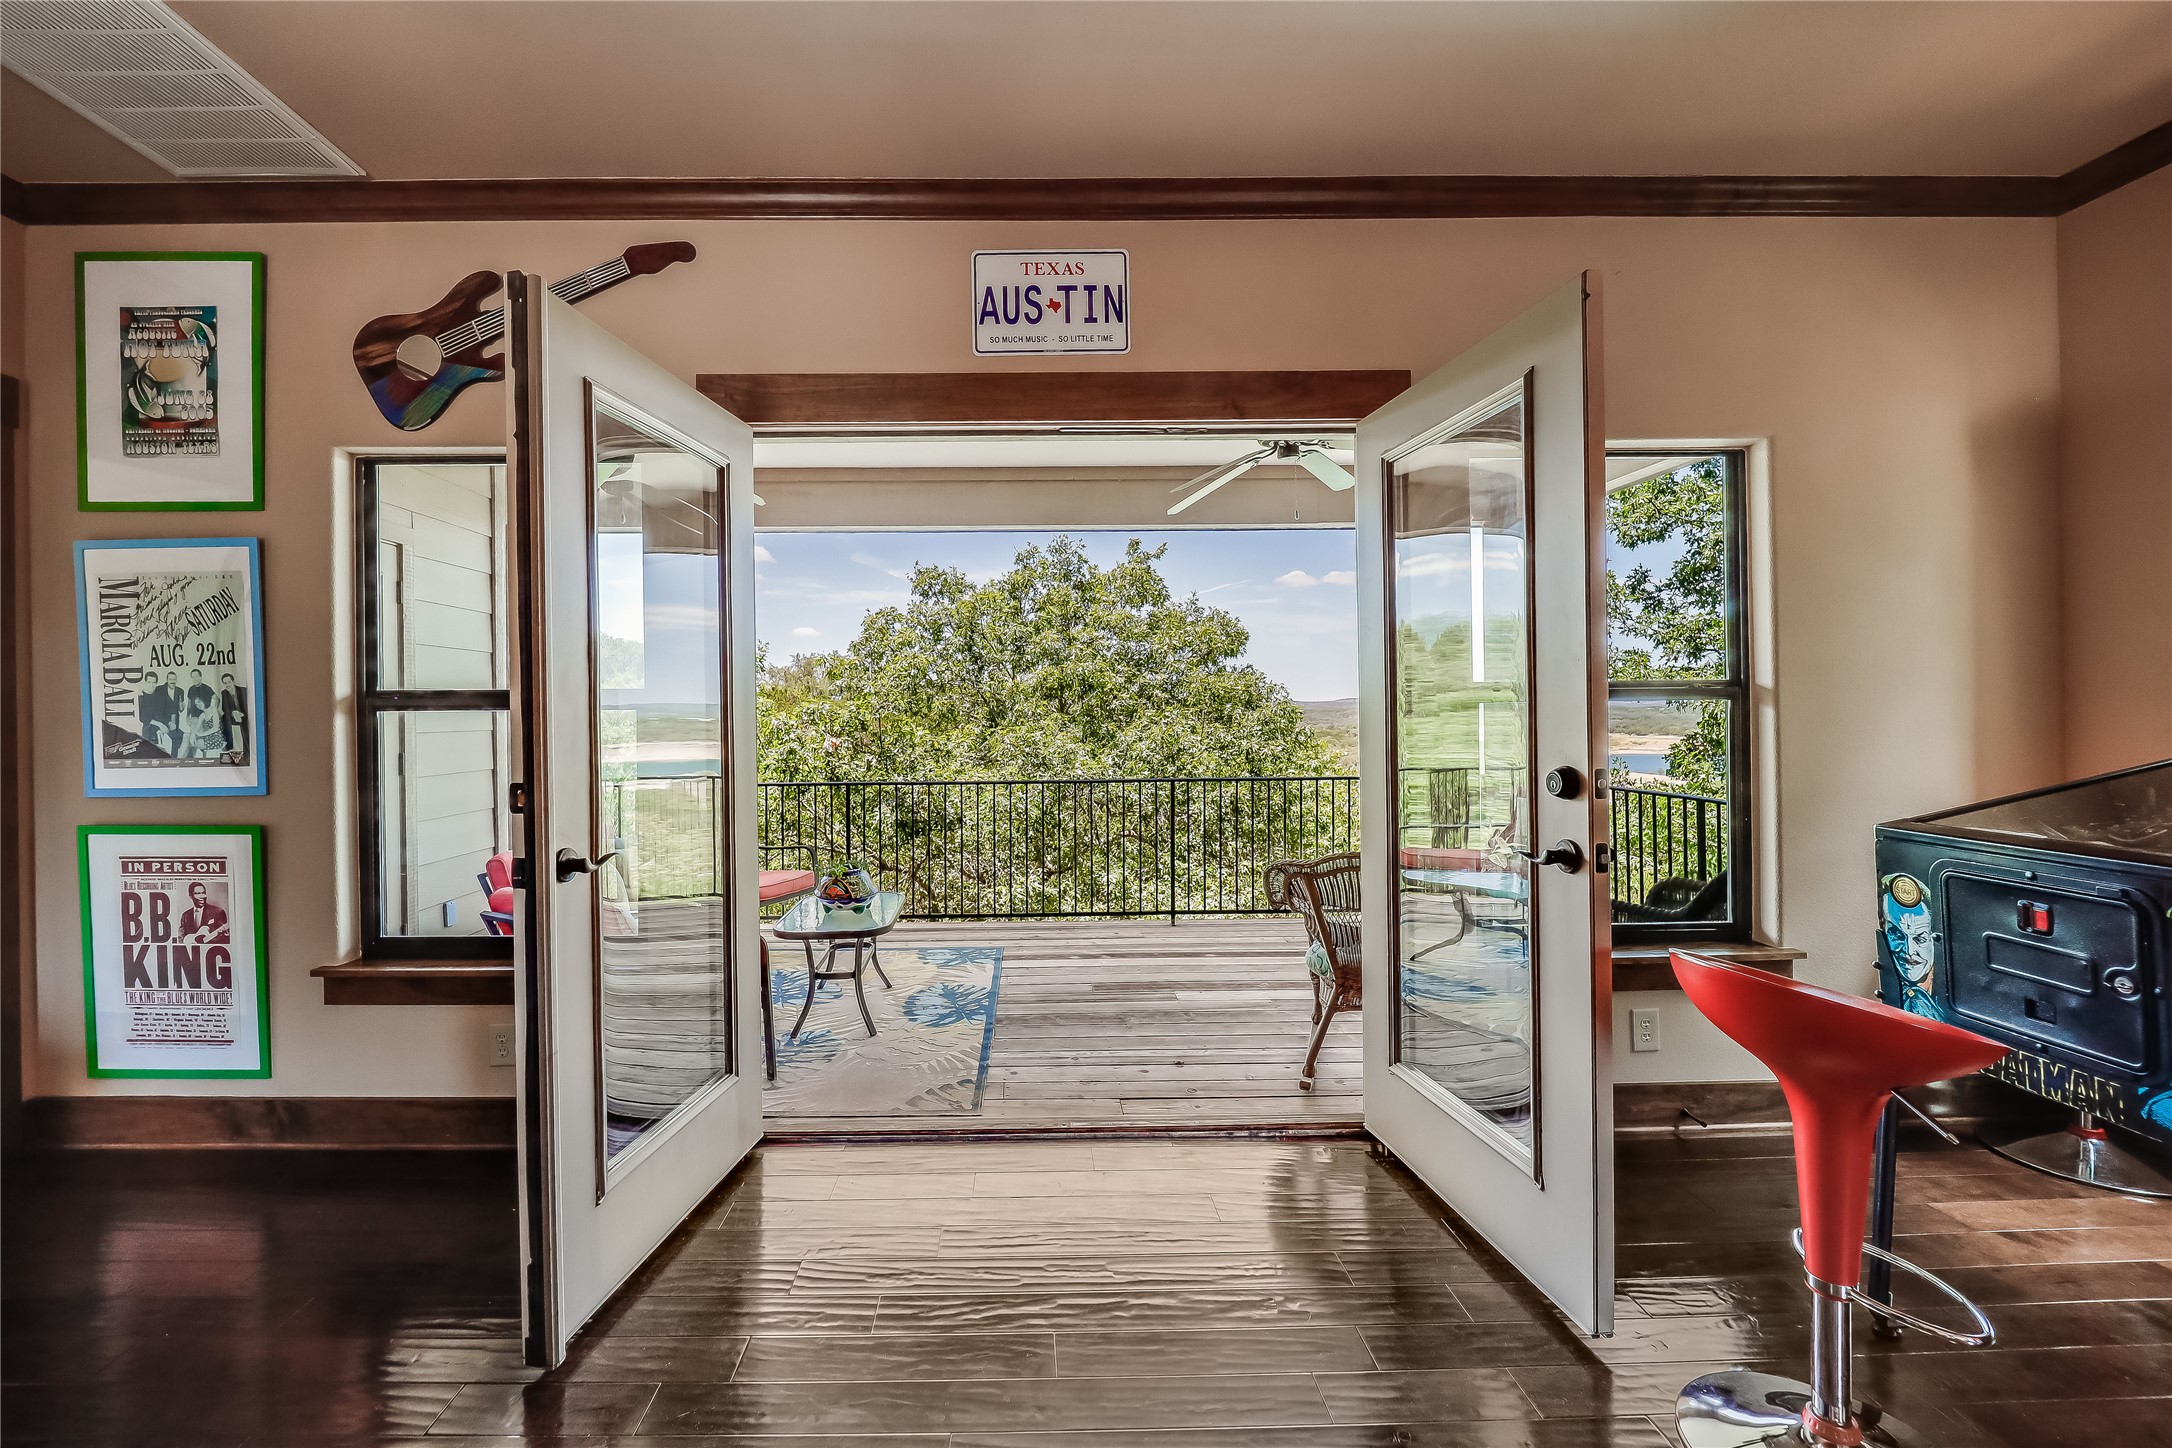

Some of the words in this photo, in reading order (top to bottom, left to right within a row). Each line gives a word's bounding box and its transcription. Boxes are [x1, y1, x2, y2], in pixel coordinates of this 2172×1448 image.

[1020, 262, 1085, 276] TEXAS
[128, 328, 177, 340] ACOUSTIC
[123, 340, 157, 358] HOT
[162, 339, 209, 358] TUNA
[157, 390, 194, 405] JUNE
[181, 404, 214, 420] 2005
[126, 441, 176, 454] HOUSTON
[182, 441, 218, 454] TEXAS
[184, 586, 240, 637] SATURDAY
[98, 576, 140, 665] MARCIA
[149, 643, 189, 667] AUG.
[196, 642, 236, 665] 22nd
[102, 665, 143, 719] BALL
[128, 862, 144, 873] IN
[151, 862, 220, 873] PERSON
[1895, 885, 1915, 896] START
[121, 891, 178, 944] B.B.
[123, 944, 233, 989] KING
[125, 992, 138, 1003] THE
[139, 992, 156, 1003] KING
[167, 992, 187, 1004] BLUES
[189, 992, 212, 1004] WORLD
[213, 993, 233, 1004] WIDE!
